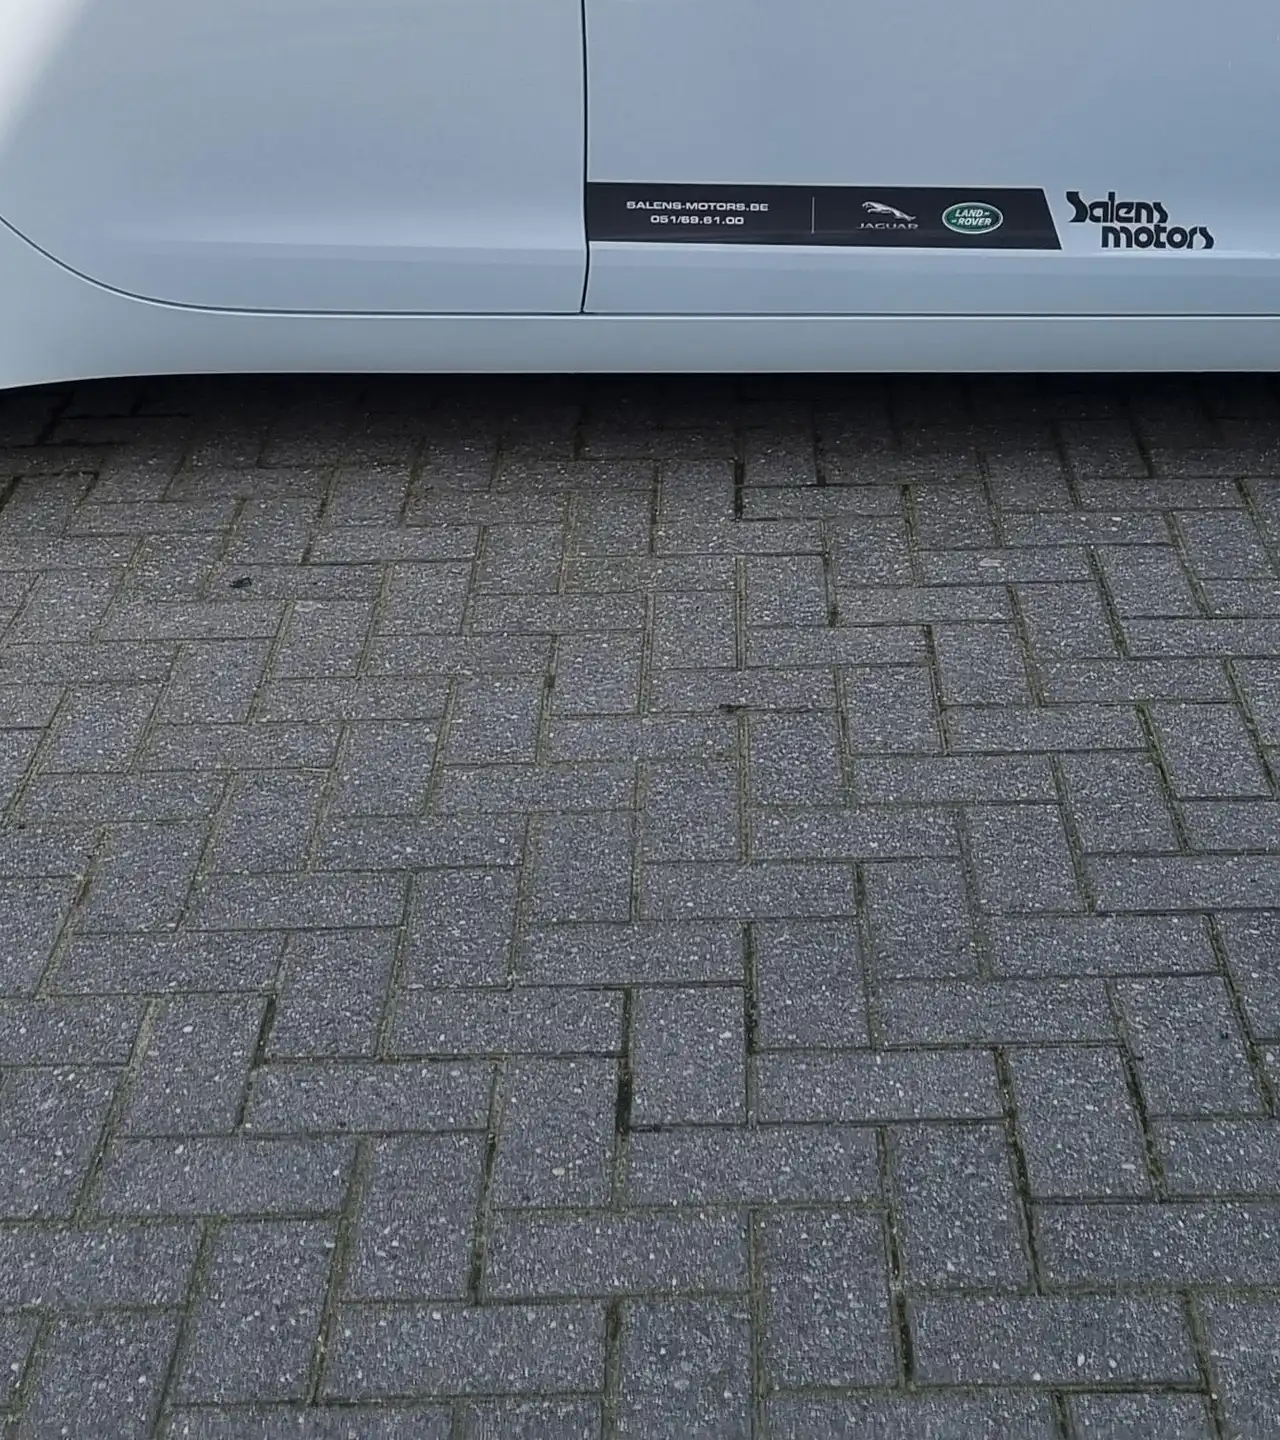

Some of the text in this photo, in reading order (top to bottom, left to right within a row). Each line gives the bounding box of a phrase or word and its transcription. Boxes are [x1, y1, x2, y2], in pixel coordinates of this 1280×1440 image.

[626, 200, 770, 212] SALENS-MOTORS.BE
[1066, 191, 1169, 224] Salens
[955, 208, 983, 218] LAND
[854, 222, 918, 230] JAGUAR
[956, 217, 992, 227] ROVER
[1101, 224, 1215, 250] motors
